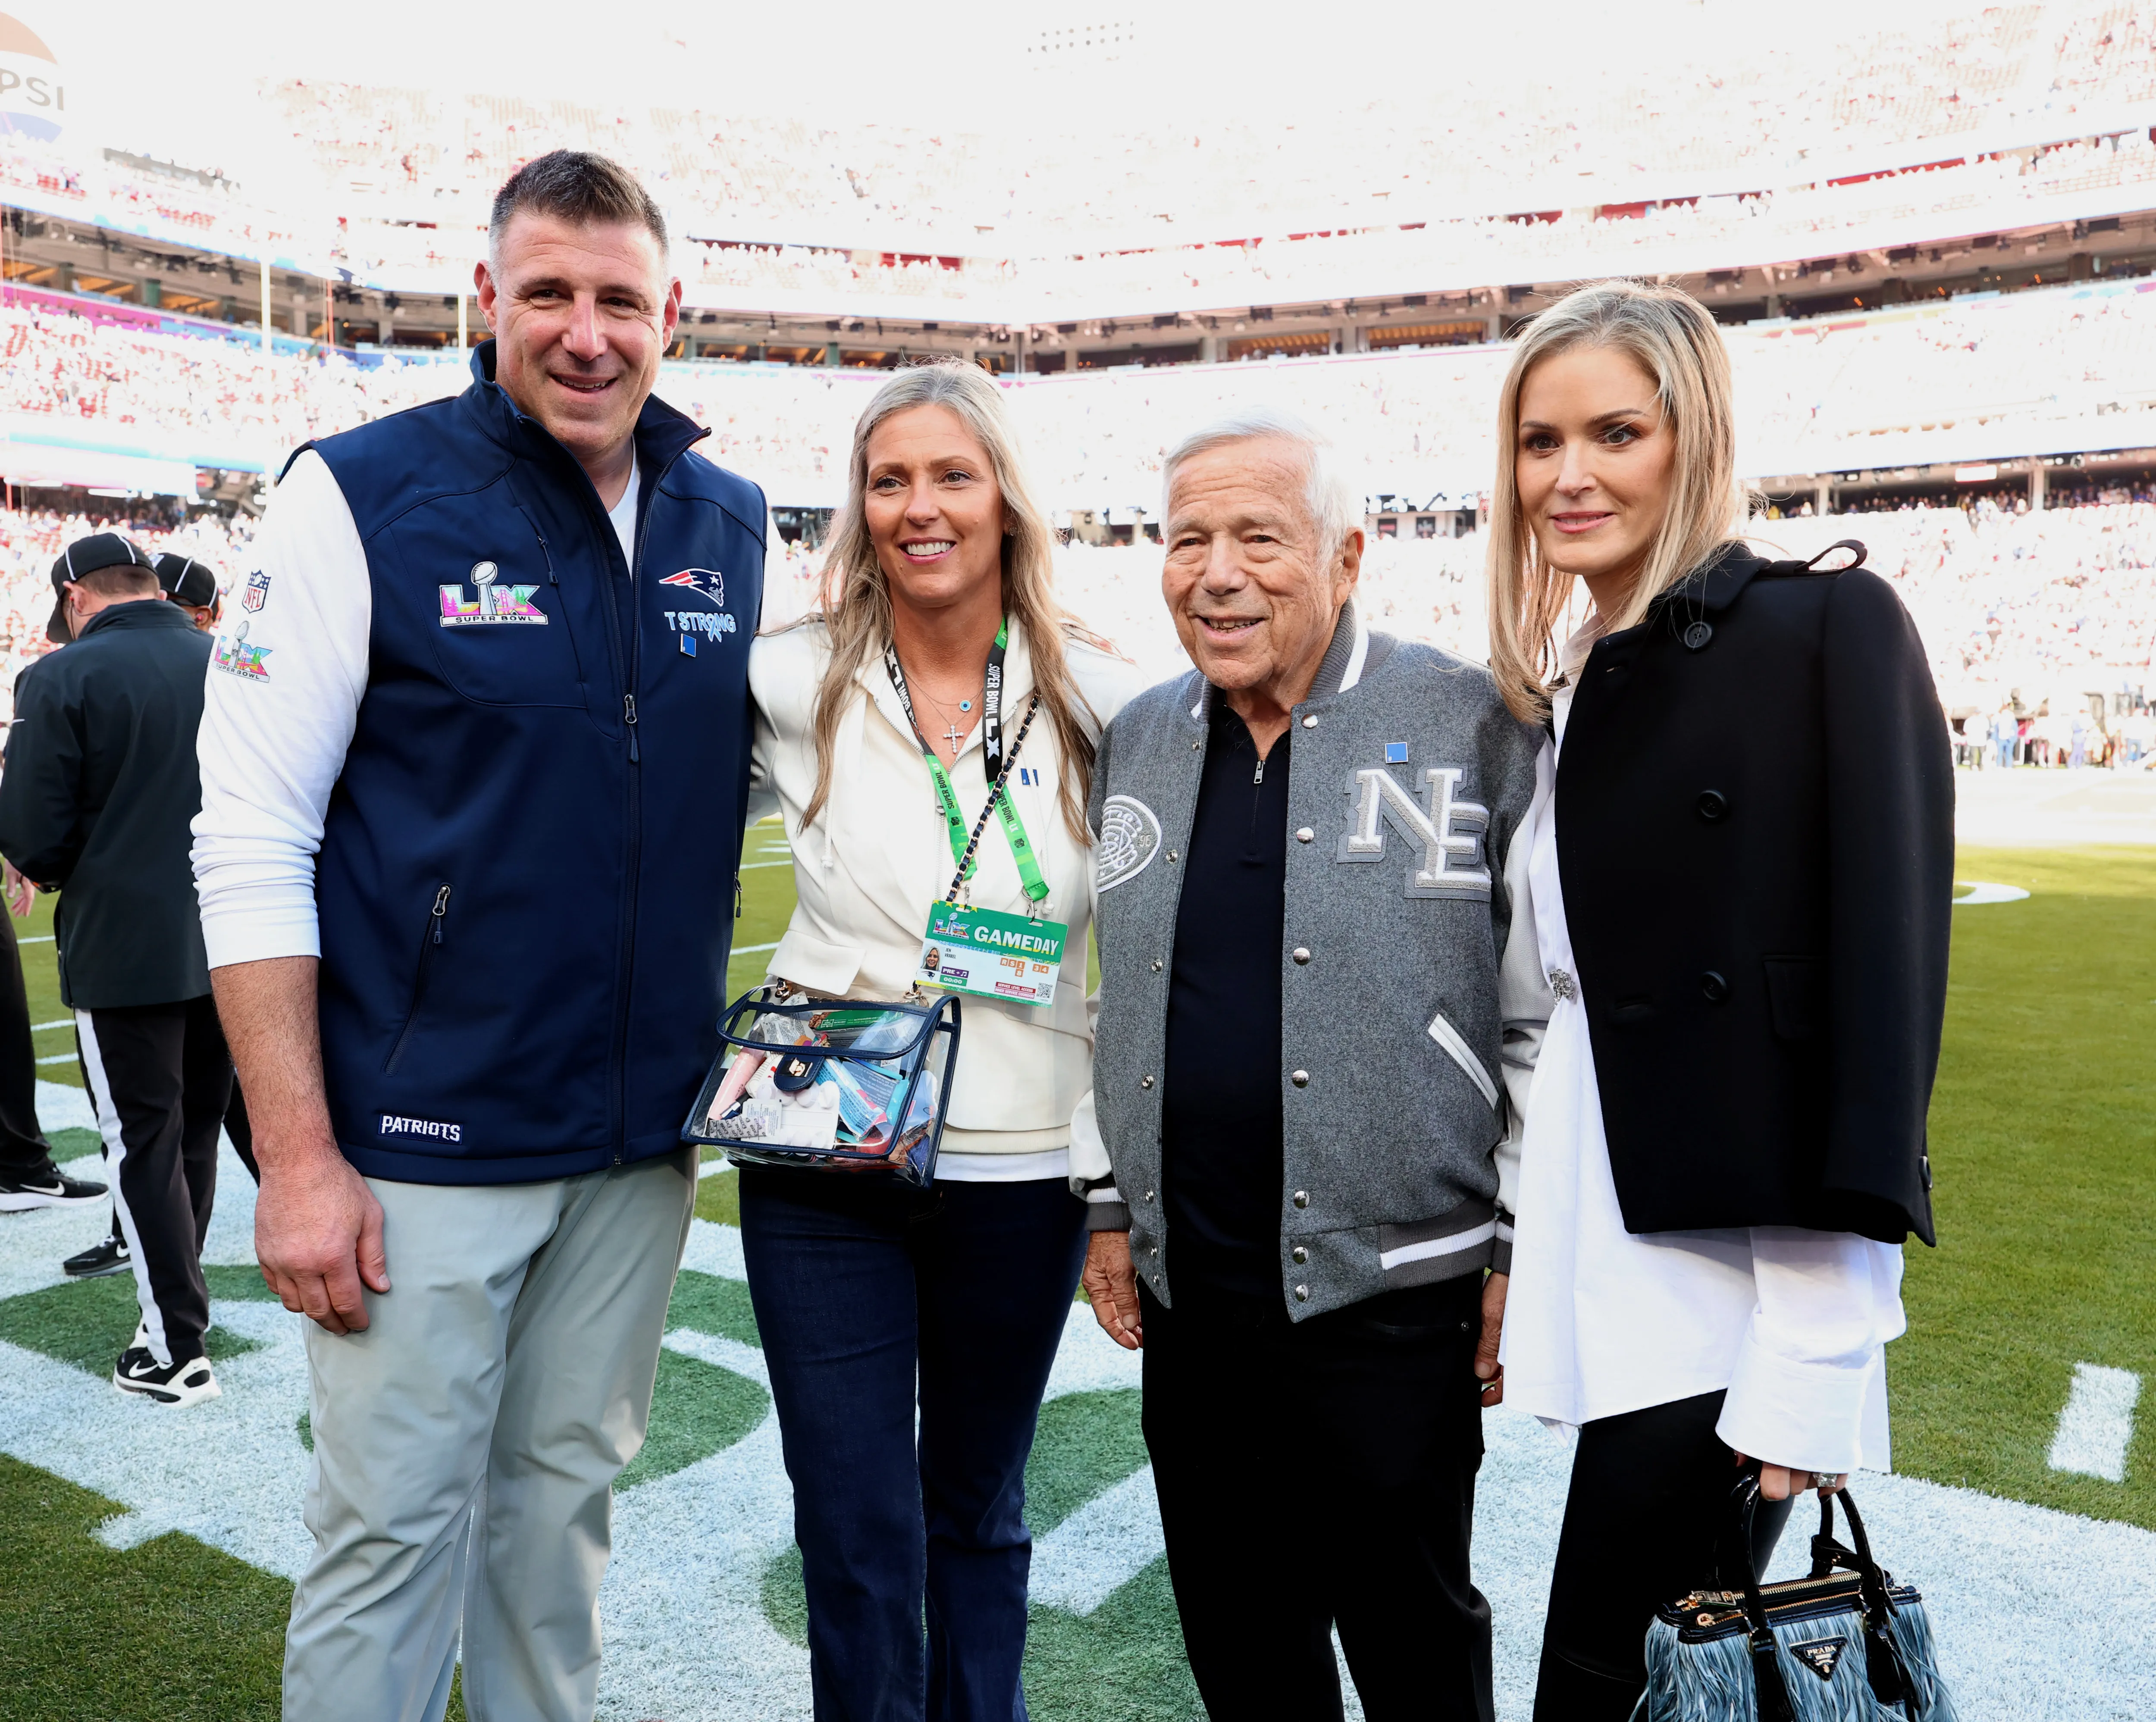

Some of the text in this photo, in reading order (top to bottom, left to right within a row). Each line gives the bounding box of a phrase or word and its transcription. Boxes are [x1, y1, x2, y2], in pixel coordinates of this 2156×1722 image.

[244, 588, 261, 609] NFL
[664, 611, 736, 634] T STRONG
[216, 663, 260, 679] SUPER BOWL
[897, 682, 911, 711] BOWL
[985, 663, 1000, 760] SUPER BOWL LX
[934, 771, 947, 789] BOWL
[942, 790, 955, 809] SUPER
[1002, 805, 1015, 824] BOWL
[1008, 823, 1019, 833] LX
[1347, 767, 1492, 889] NE
[381, 1115, 460, 1142] PATRIOTS
[1807, 1645, 1836, 1656] PRADA
